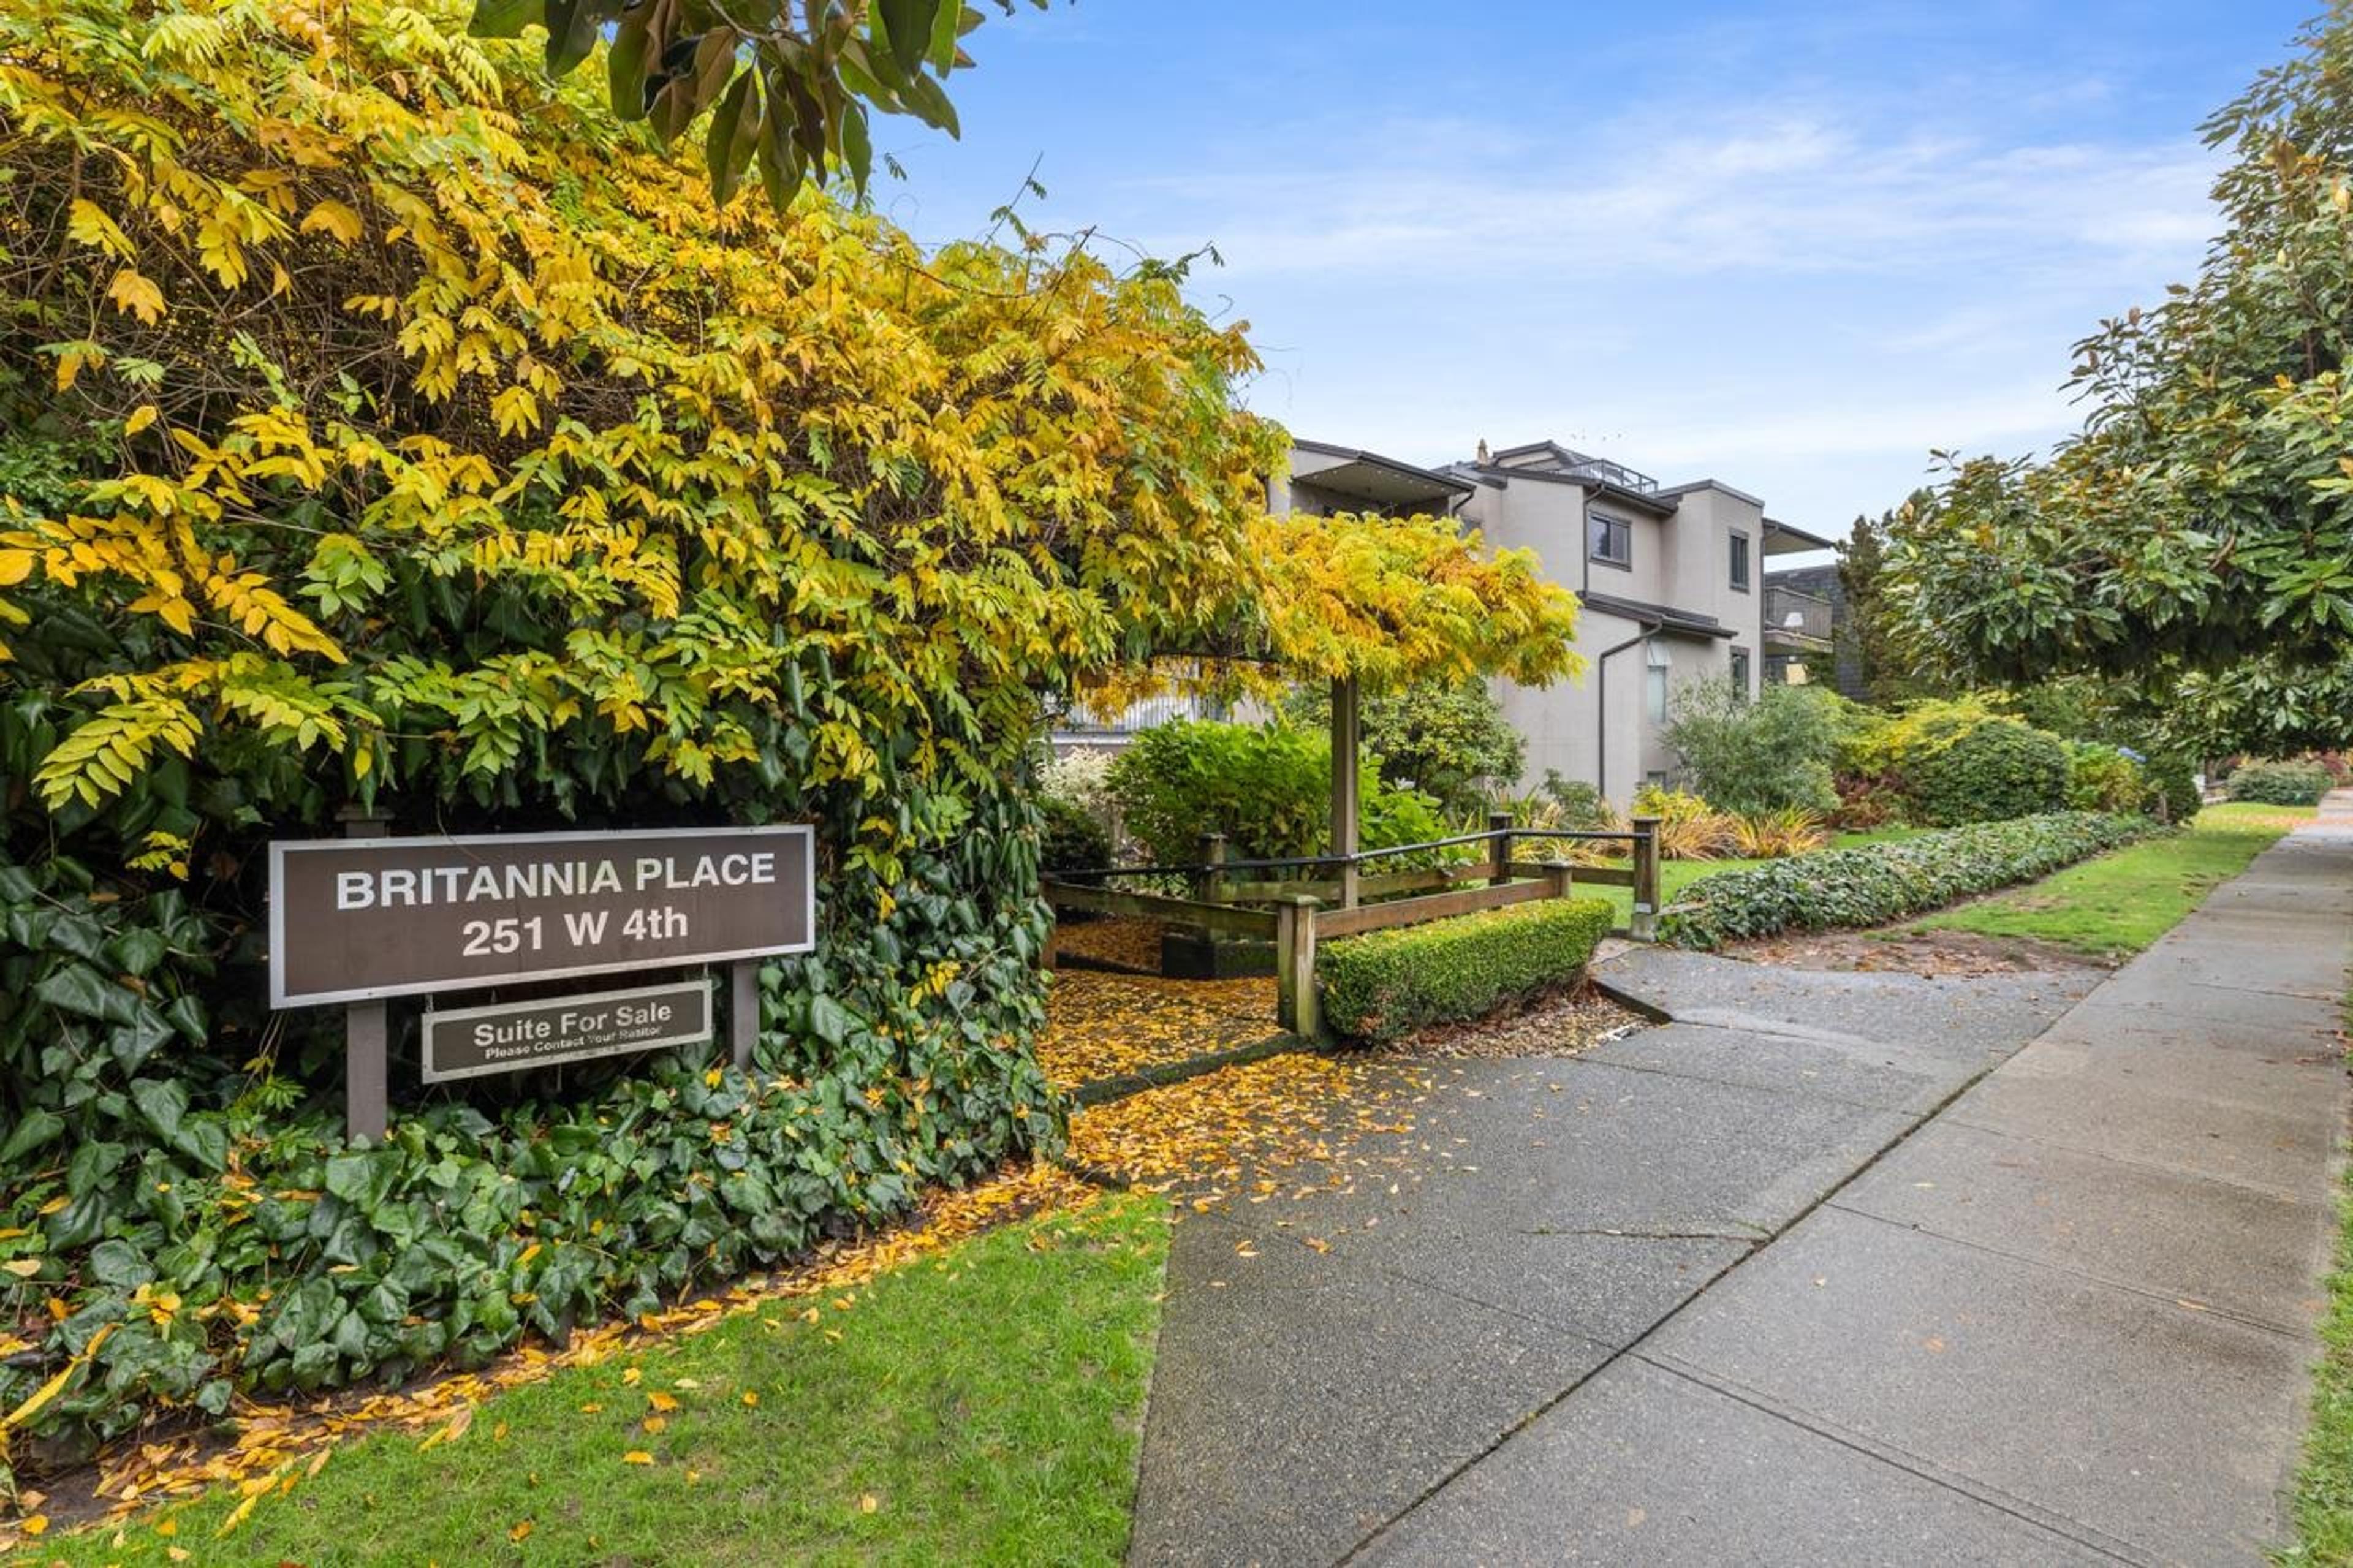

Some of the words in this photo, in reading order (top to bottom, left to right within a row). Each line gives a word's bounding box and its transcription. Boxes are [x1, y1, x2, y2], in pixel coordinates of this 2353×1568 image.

[336, 860, 621, 909] BRITANNIA
[635, 853, 775, 891] PLACE
[463, 917, 543, 956] 251
[564, 912, 608, 947] W
[623, 907, 689, 942] 4th
[474, 1020, 551, 1047] Suite
[560, 1012, 608, 1034] For
[615, 1002, 672, 1026] Sale
[485, 1044, 530, 1060] Please
[534, 1036, 585, 1051] Contact
